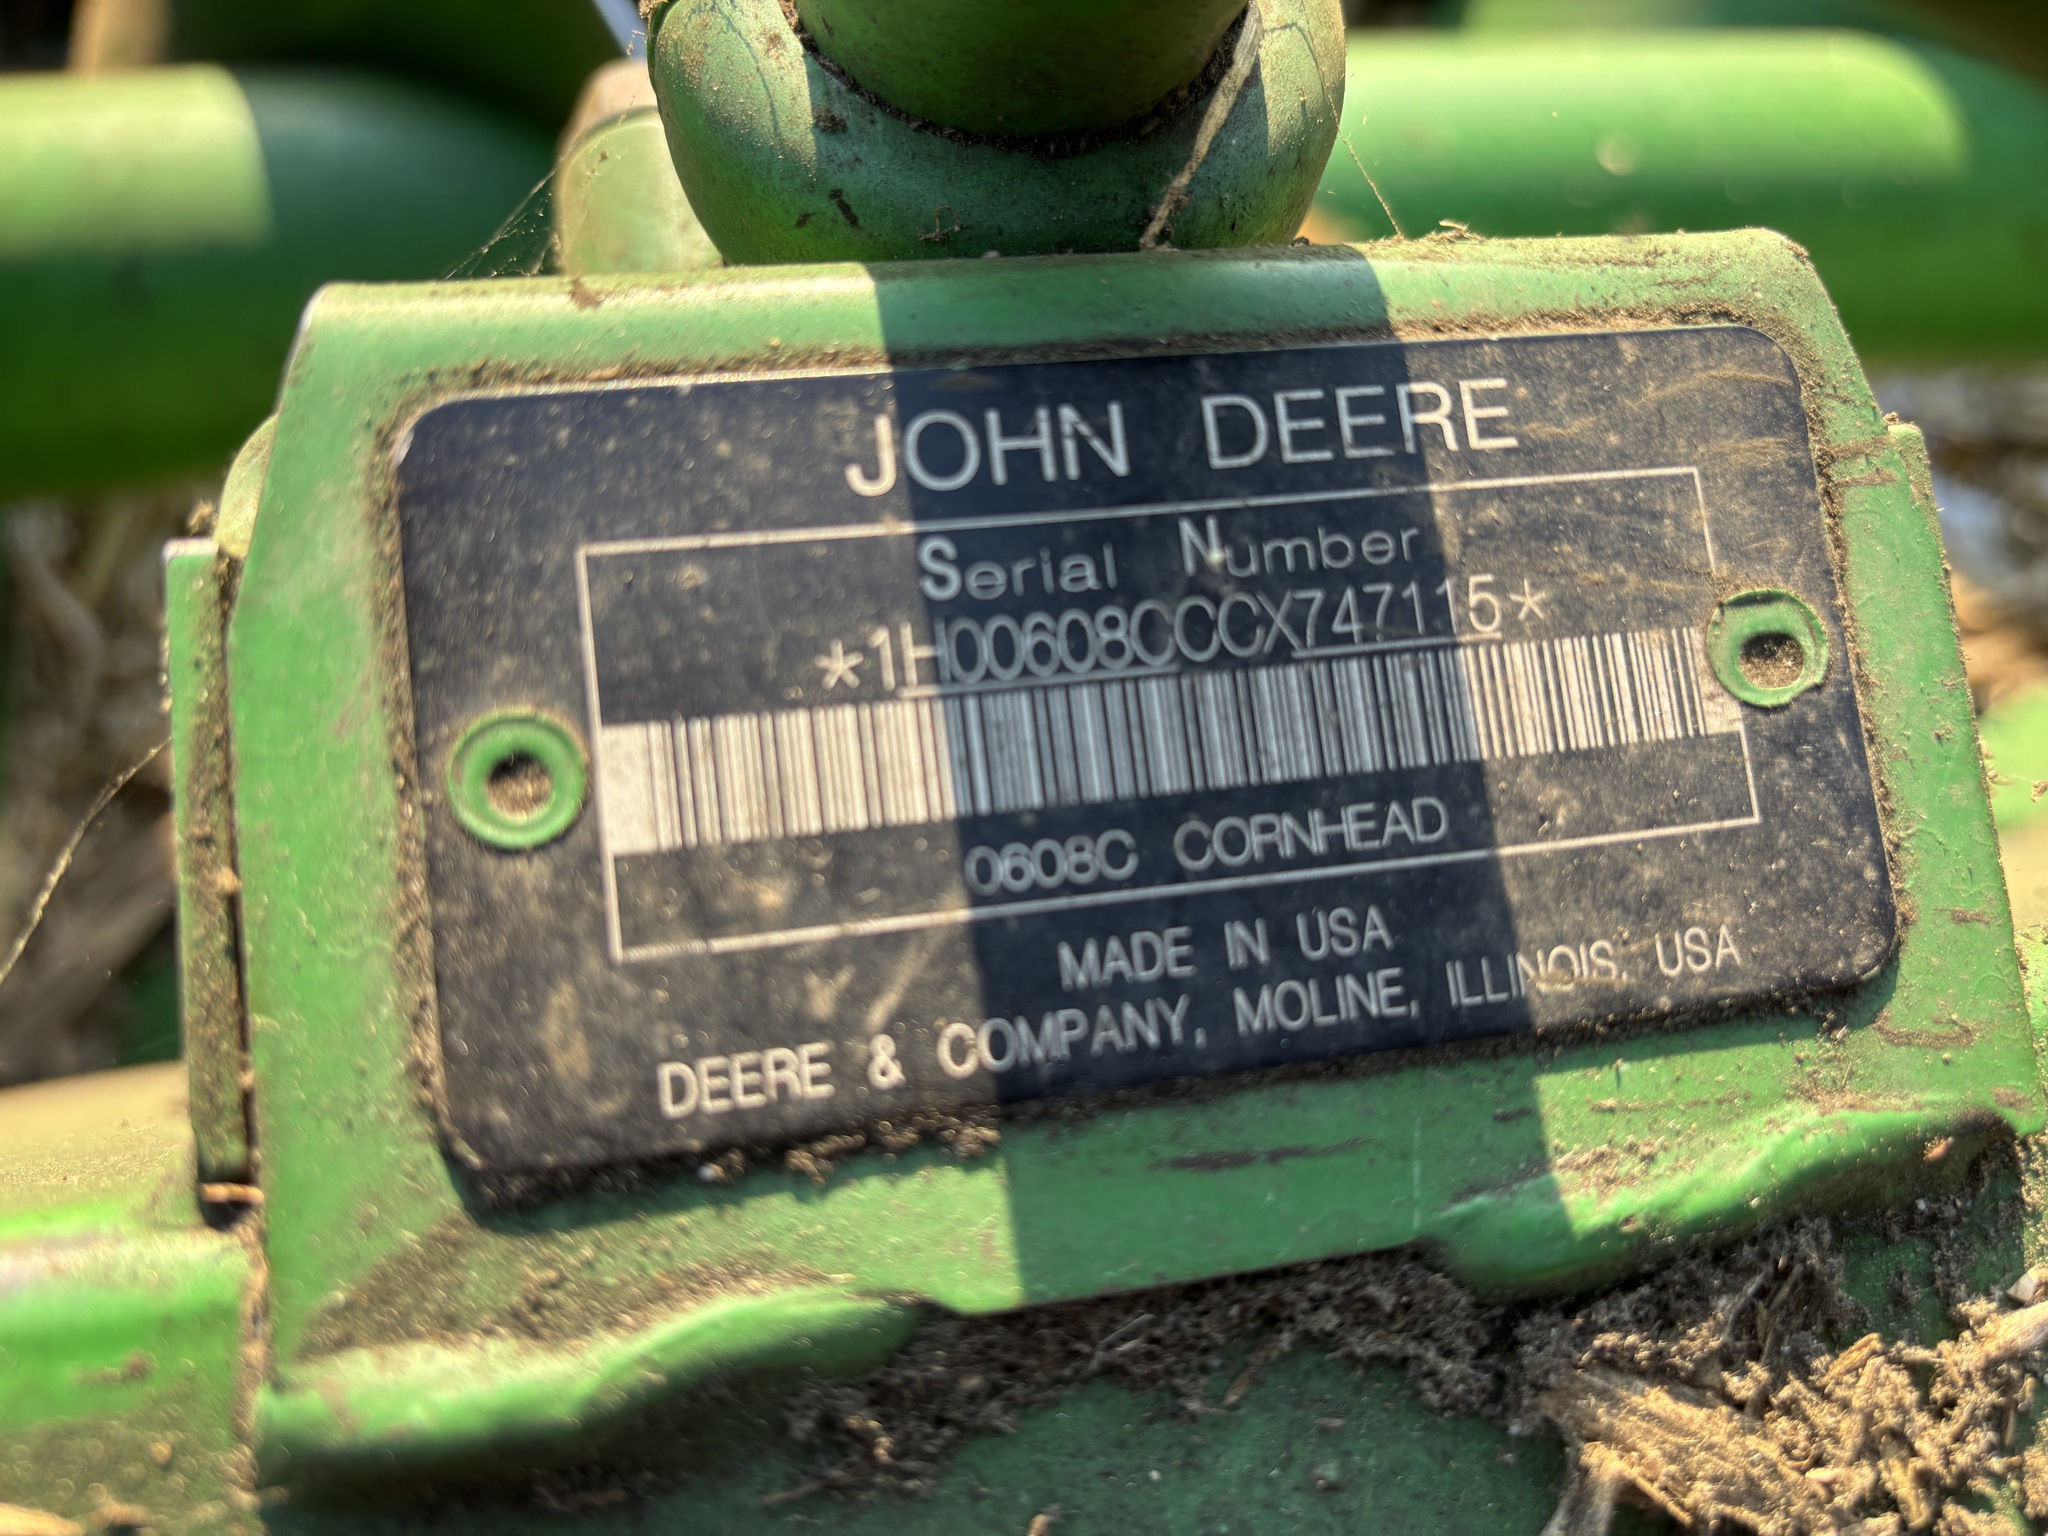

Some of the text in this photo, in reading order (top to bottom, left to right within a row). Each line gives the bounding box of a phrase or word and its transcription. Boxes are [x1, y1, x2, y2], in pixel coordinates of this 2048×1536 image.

[846, 378, 1520, 497] JOHN DEERE
[918, 516, 1420, 601] Serial Number
[964, 796, 1449, 896] 0608C CORNHEAD
[1057, 905, 1395, 991] MADE IN USA
[657, 1041, 836, 1121] DEERE
[868, 1033, 906, 1091] &
[936, 994, 1207, 1080] COMPANY,
[1233, 966, 1420, 1038] MOLINE,
[1655, 923, 1742, 979] USA
